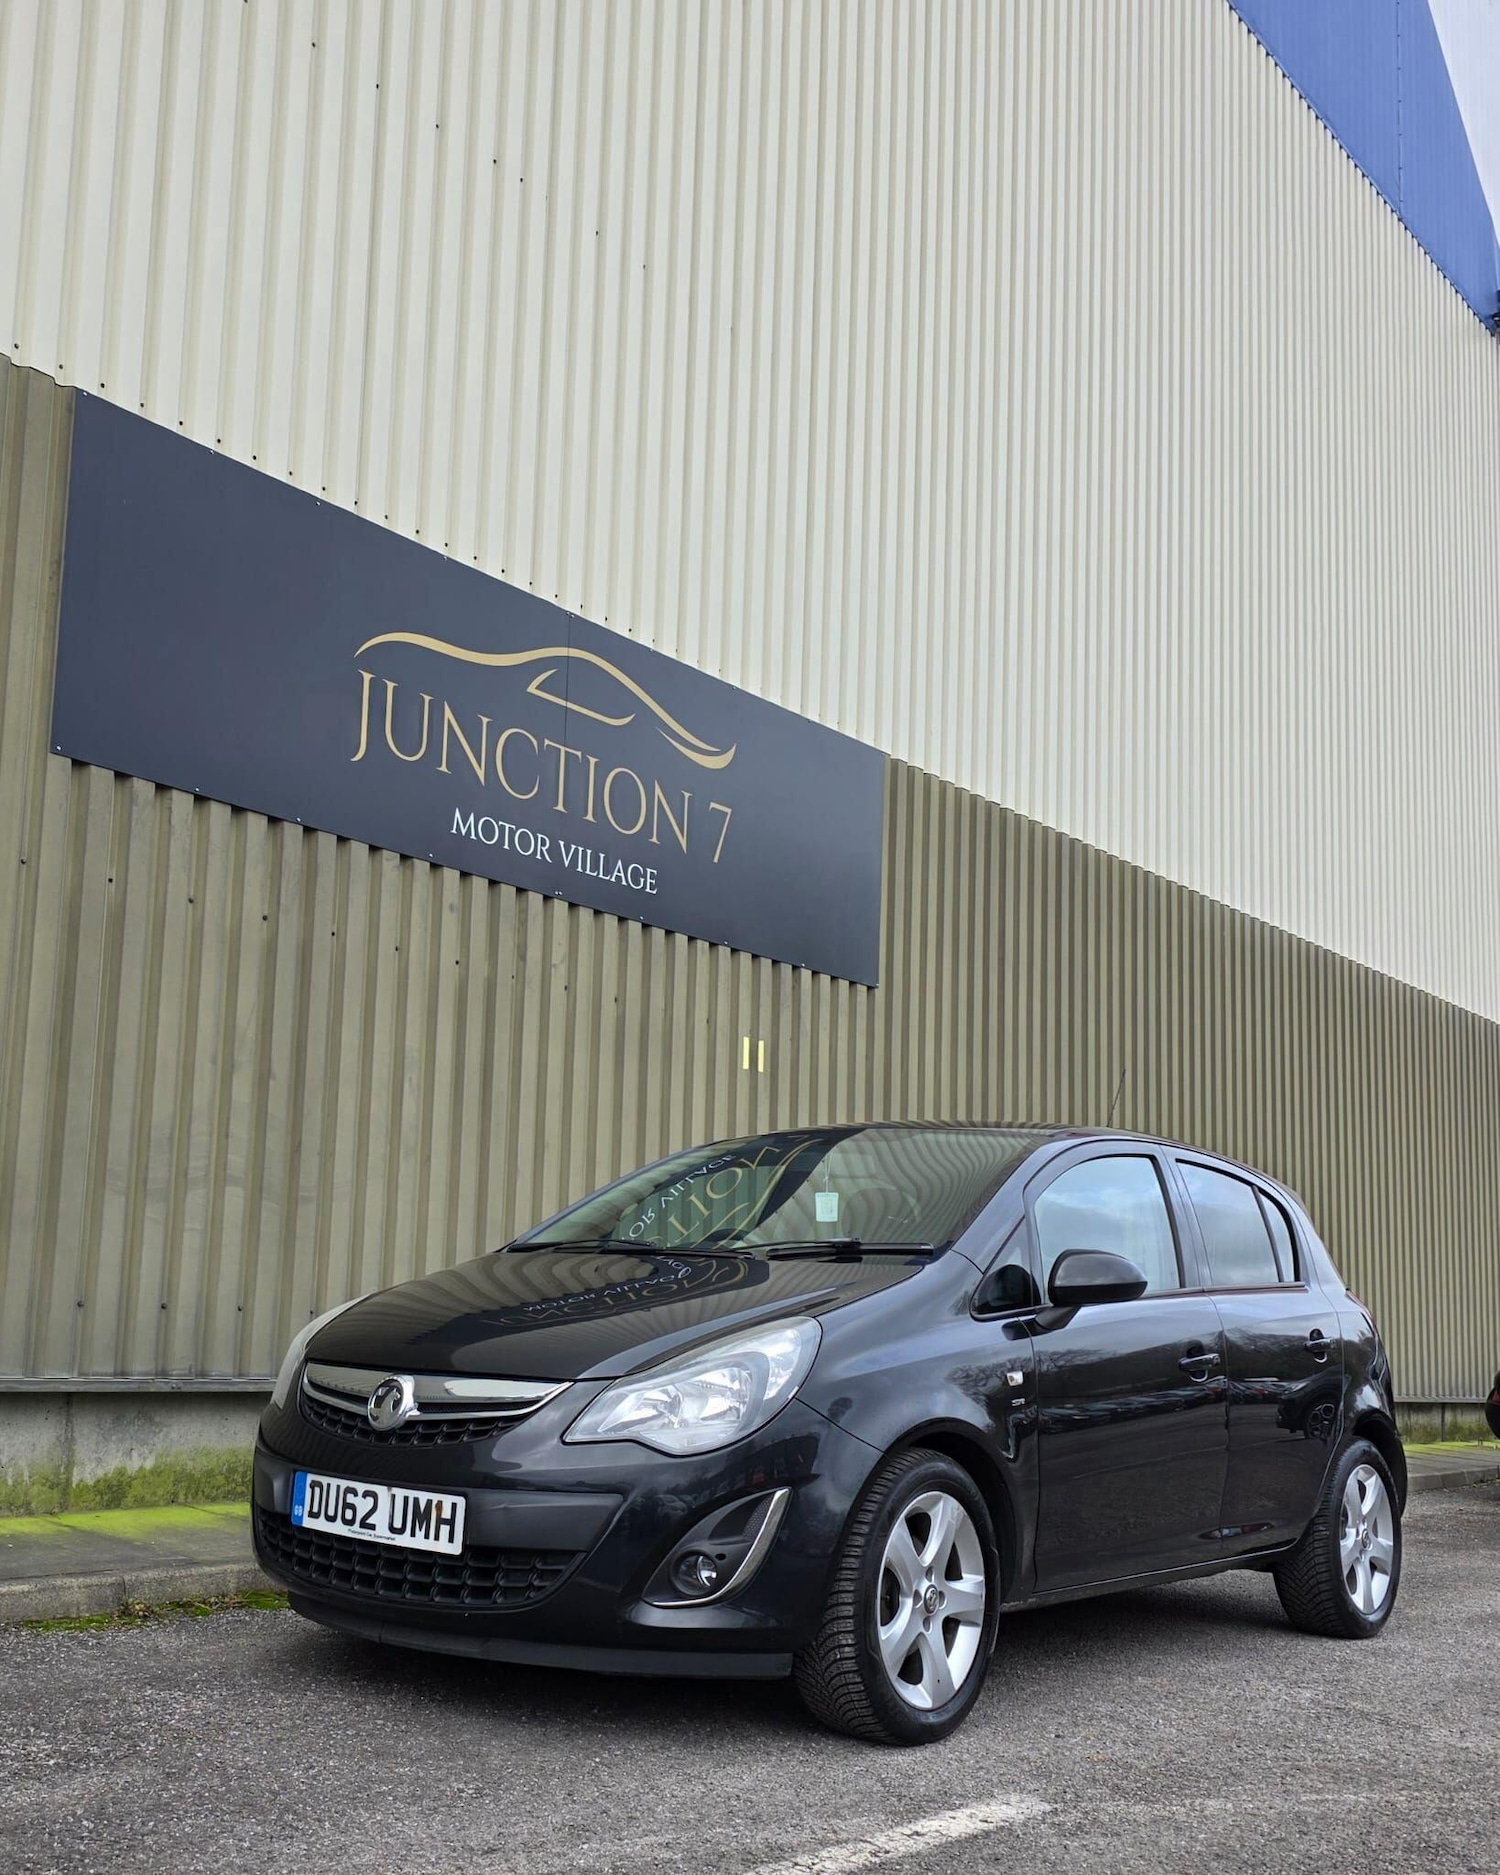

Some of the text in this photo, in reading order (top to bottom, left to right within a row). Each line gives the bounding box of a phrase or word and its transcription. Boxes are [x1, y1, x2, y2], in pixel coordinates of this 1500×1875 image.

[350, 669, 733, 863] JUNCTION 7
[450, 807, 659, 895] MOTOR VILLAGE
[307, 1479, 457, 1543] DU62 UMH
